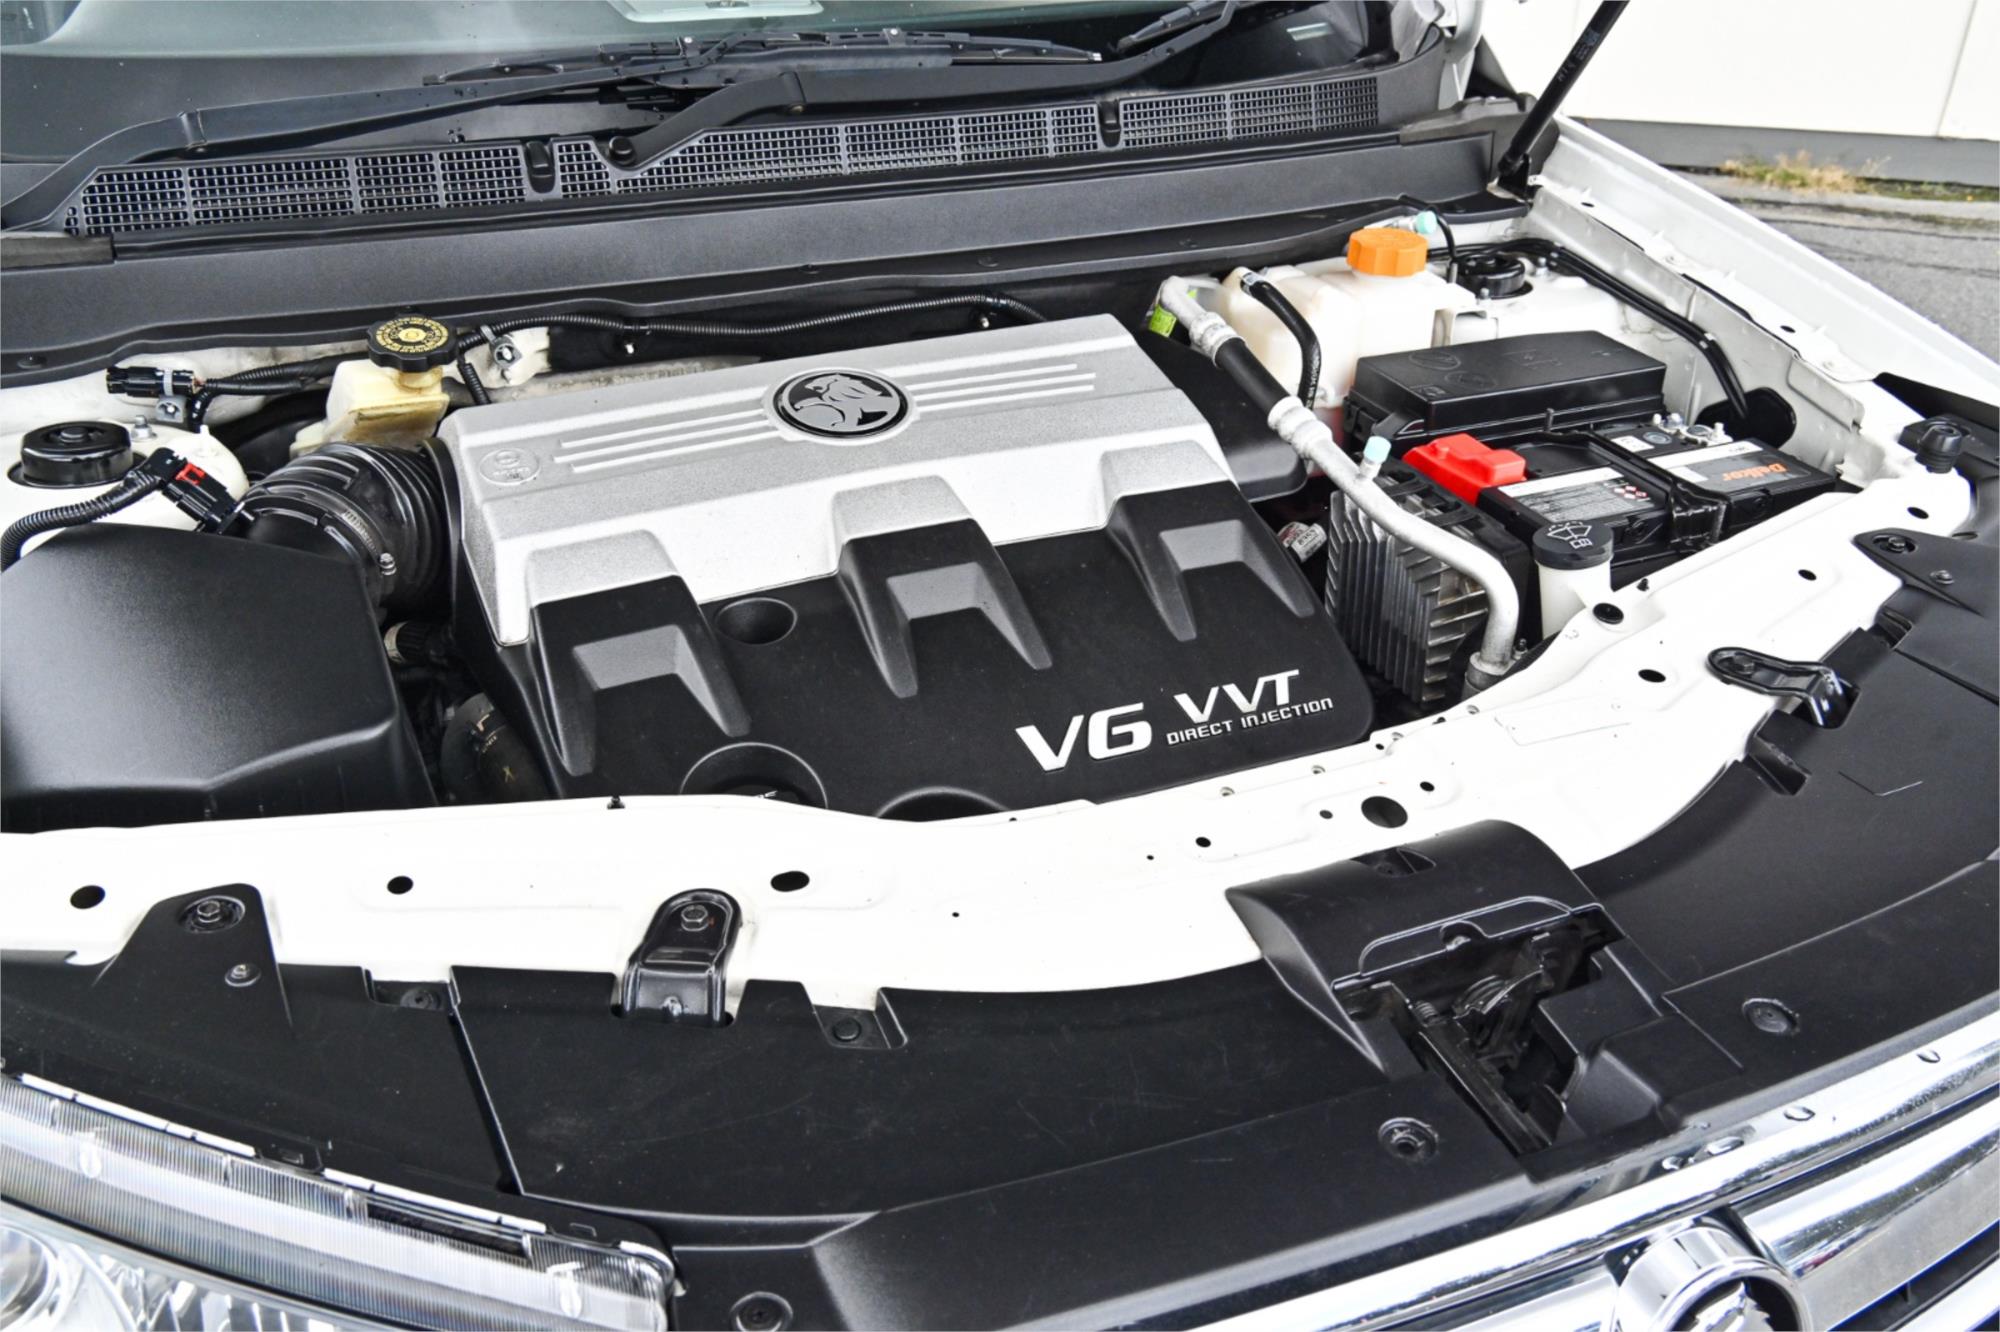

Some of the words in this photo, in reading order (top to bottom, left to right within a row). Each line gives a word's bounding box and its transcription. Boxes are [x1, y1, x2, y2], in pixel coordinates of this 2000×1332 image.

[1015, 702, 1152, 771] V6
[1174, 669, 1299, 723] VVT
[1167, 720, 1232, 745] DIRECT
[1241, 697, 1333, 728] INJECTION
